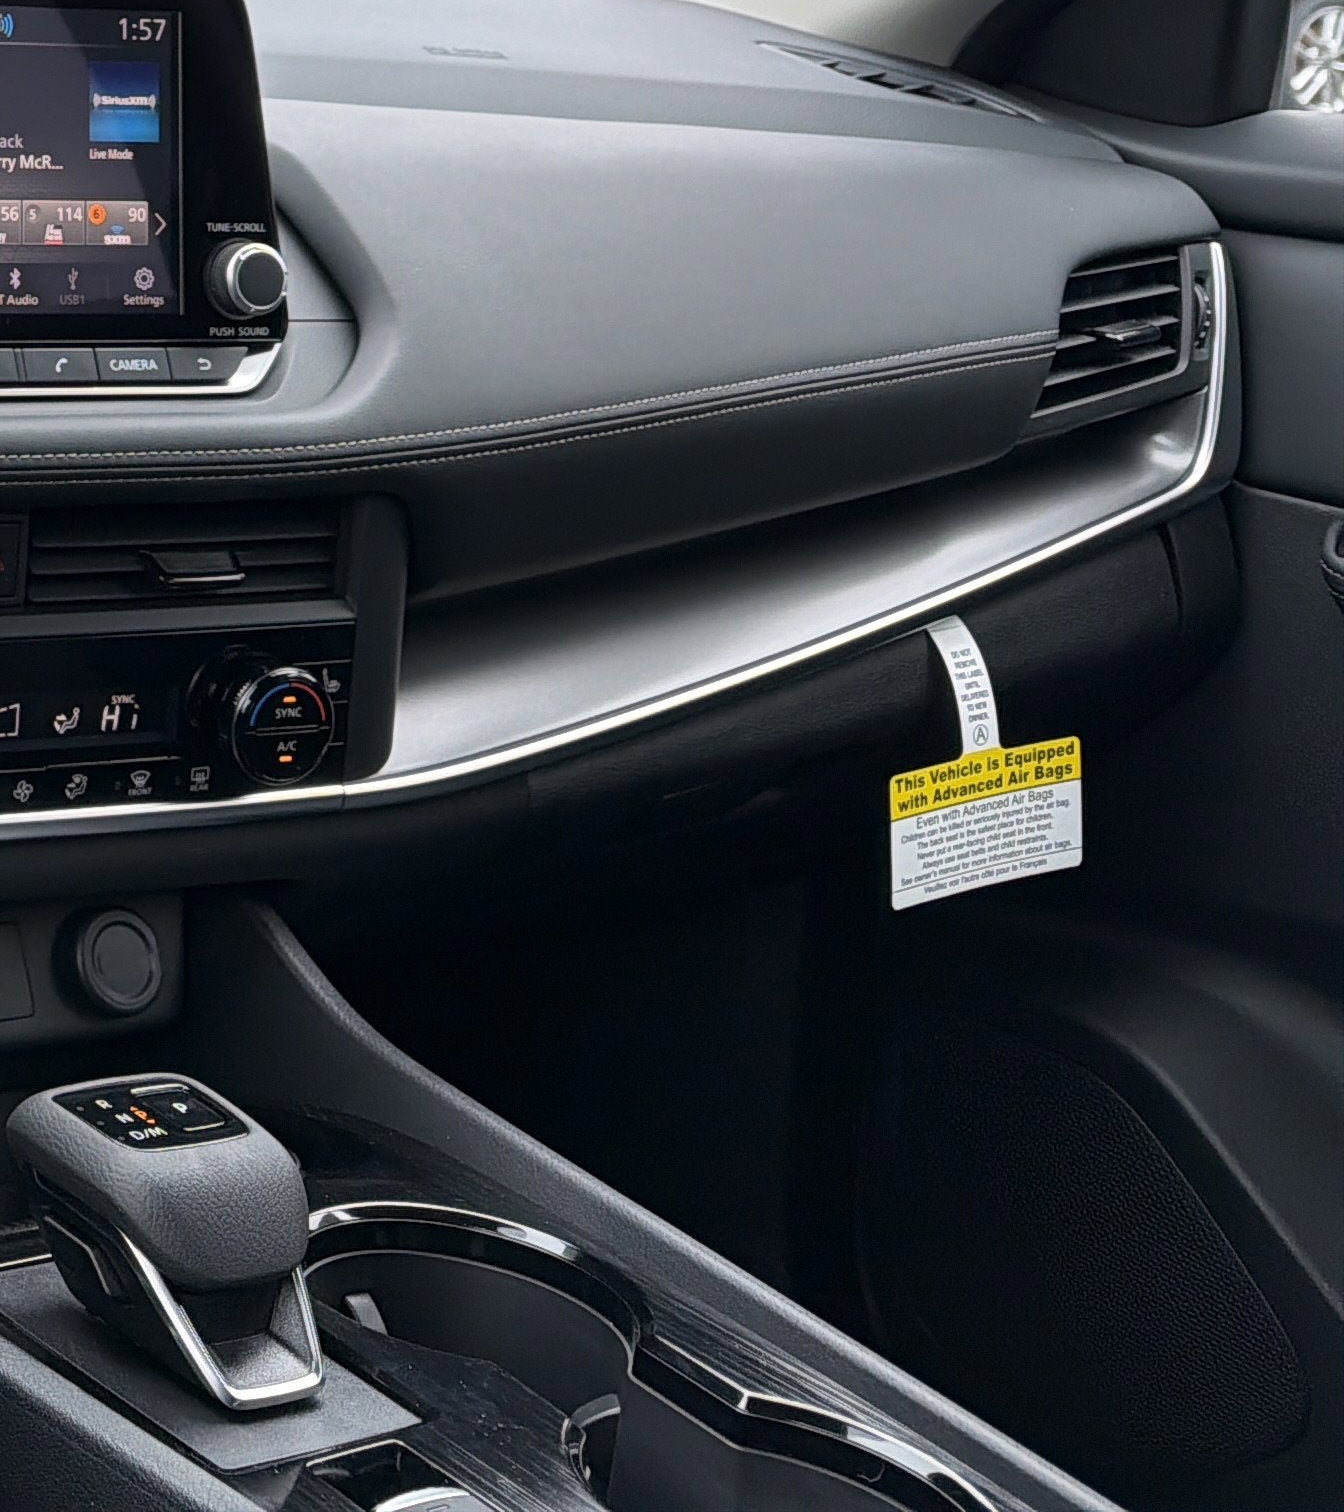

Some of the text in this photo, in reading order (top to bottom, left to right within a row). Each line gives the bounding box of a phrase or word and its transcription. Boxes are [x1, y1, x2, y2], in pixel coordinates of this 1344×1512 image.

[119, 18, 166, 41] 1:57
[89, 149, 133, 160] Live Mode
[20, 154, 64, 170] McR...
[0, 206, 19, 221] 56
[29, 208, 36, 220] 5
[57, 207, 82, 222] 114
[128, 208, 146, 222] 90
[7, 294, 38, 306] Audio
[60, 294, 85, 305] USB1
[123, 294, 164, 308] Settings
[210, 327, 270, 336] PUSH SOUND
[110, 358, 158, 372] CAMERA
[111, 694, 135, 704] SYNC
[100, 704, 140, 732] Hi
[275, 707, 302, 719] SYNC
[277, 740, 298, 752] A/C
[894, 740, 1074, 793] This Vehicle is Equipped
[897, 763, 1072, 812] with Advanced Air Bags
[916, 789, 1054, 829] Even with Advanced Air Bags
[900, 831, 925, 844] Children
[95, 1099, 112, 1110] R
[172, 1102, 188, 1114] P
[115, 1113, 134, 1124] N
[129, 1126, 168, 1140] D/M
